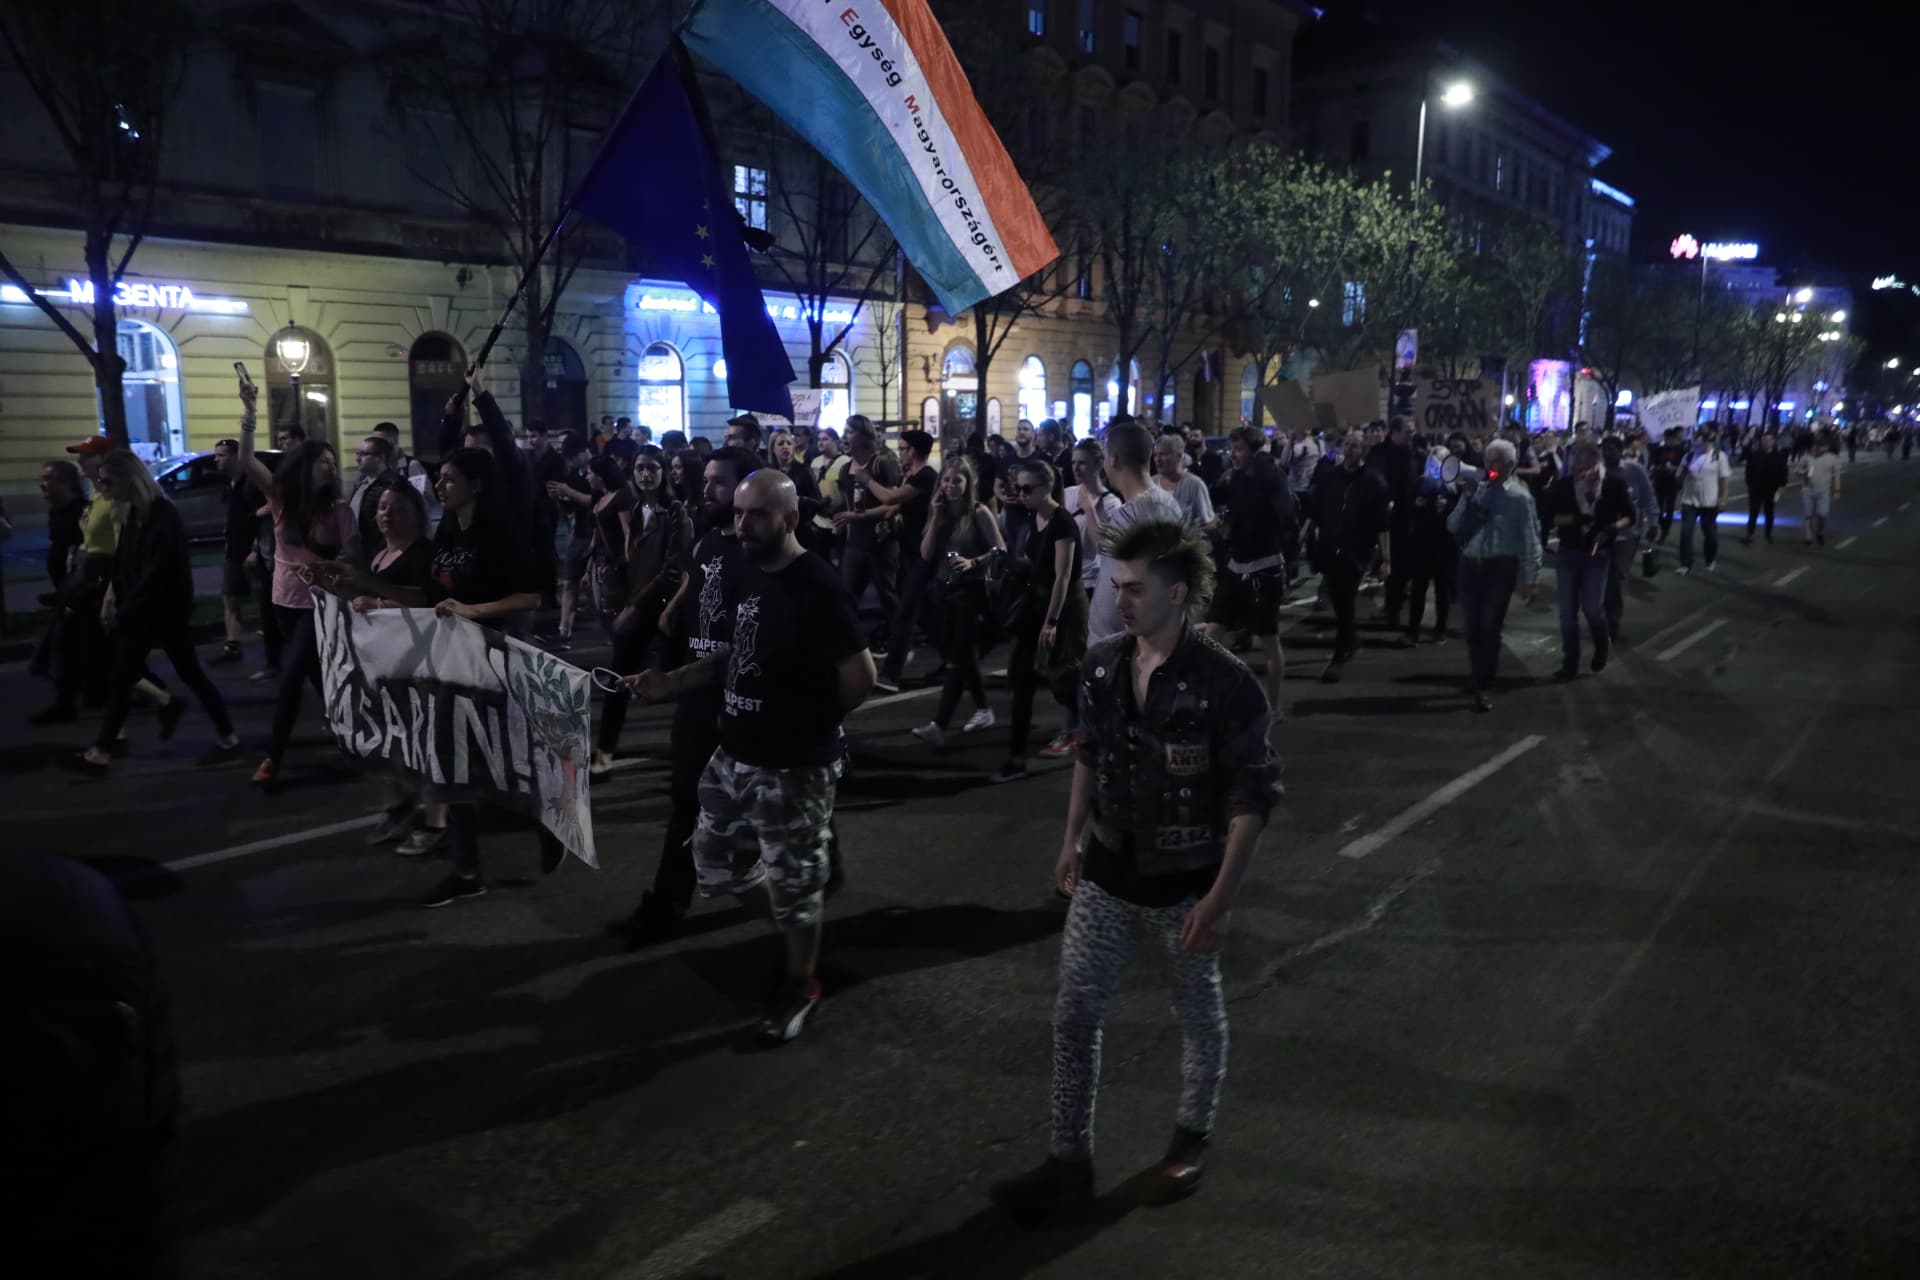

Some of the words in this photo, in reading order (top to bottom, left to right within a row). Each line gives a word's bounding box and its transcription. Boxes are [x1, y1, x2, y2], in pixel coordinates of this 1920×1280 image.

[839, 7, 903, 88] Egység
[903, 94, 1003, 272] Magyarországért
[70, 279, 193, 308] MGENTA
